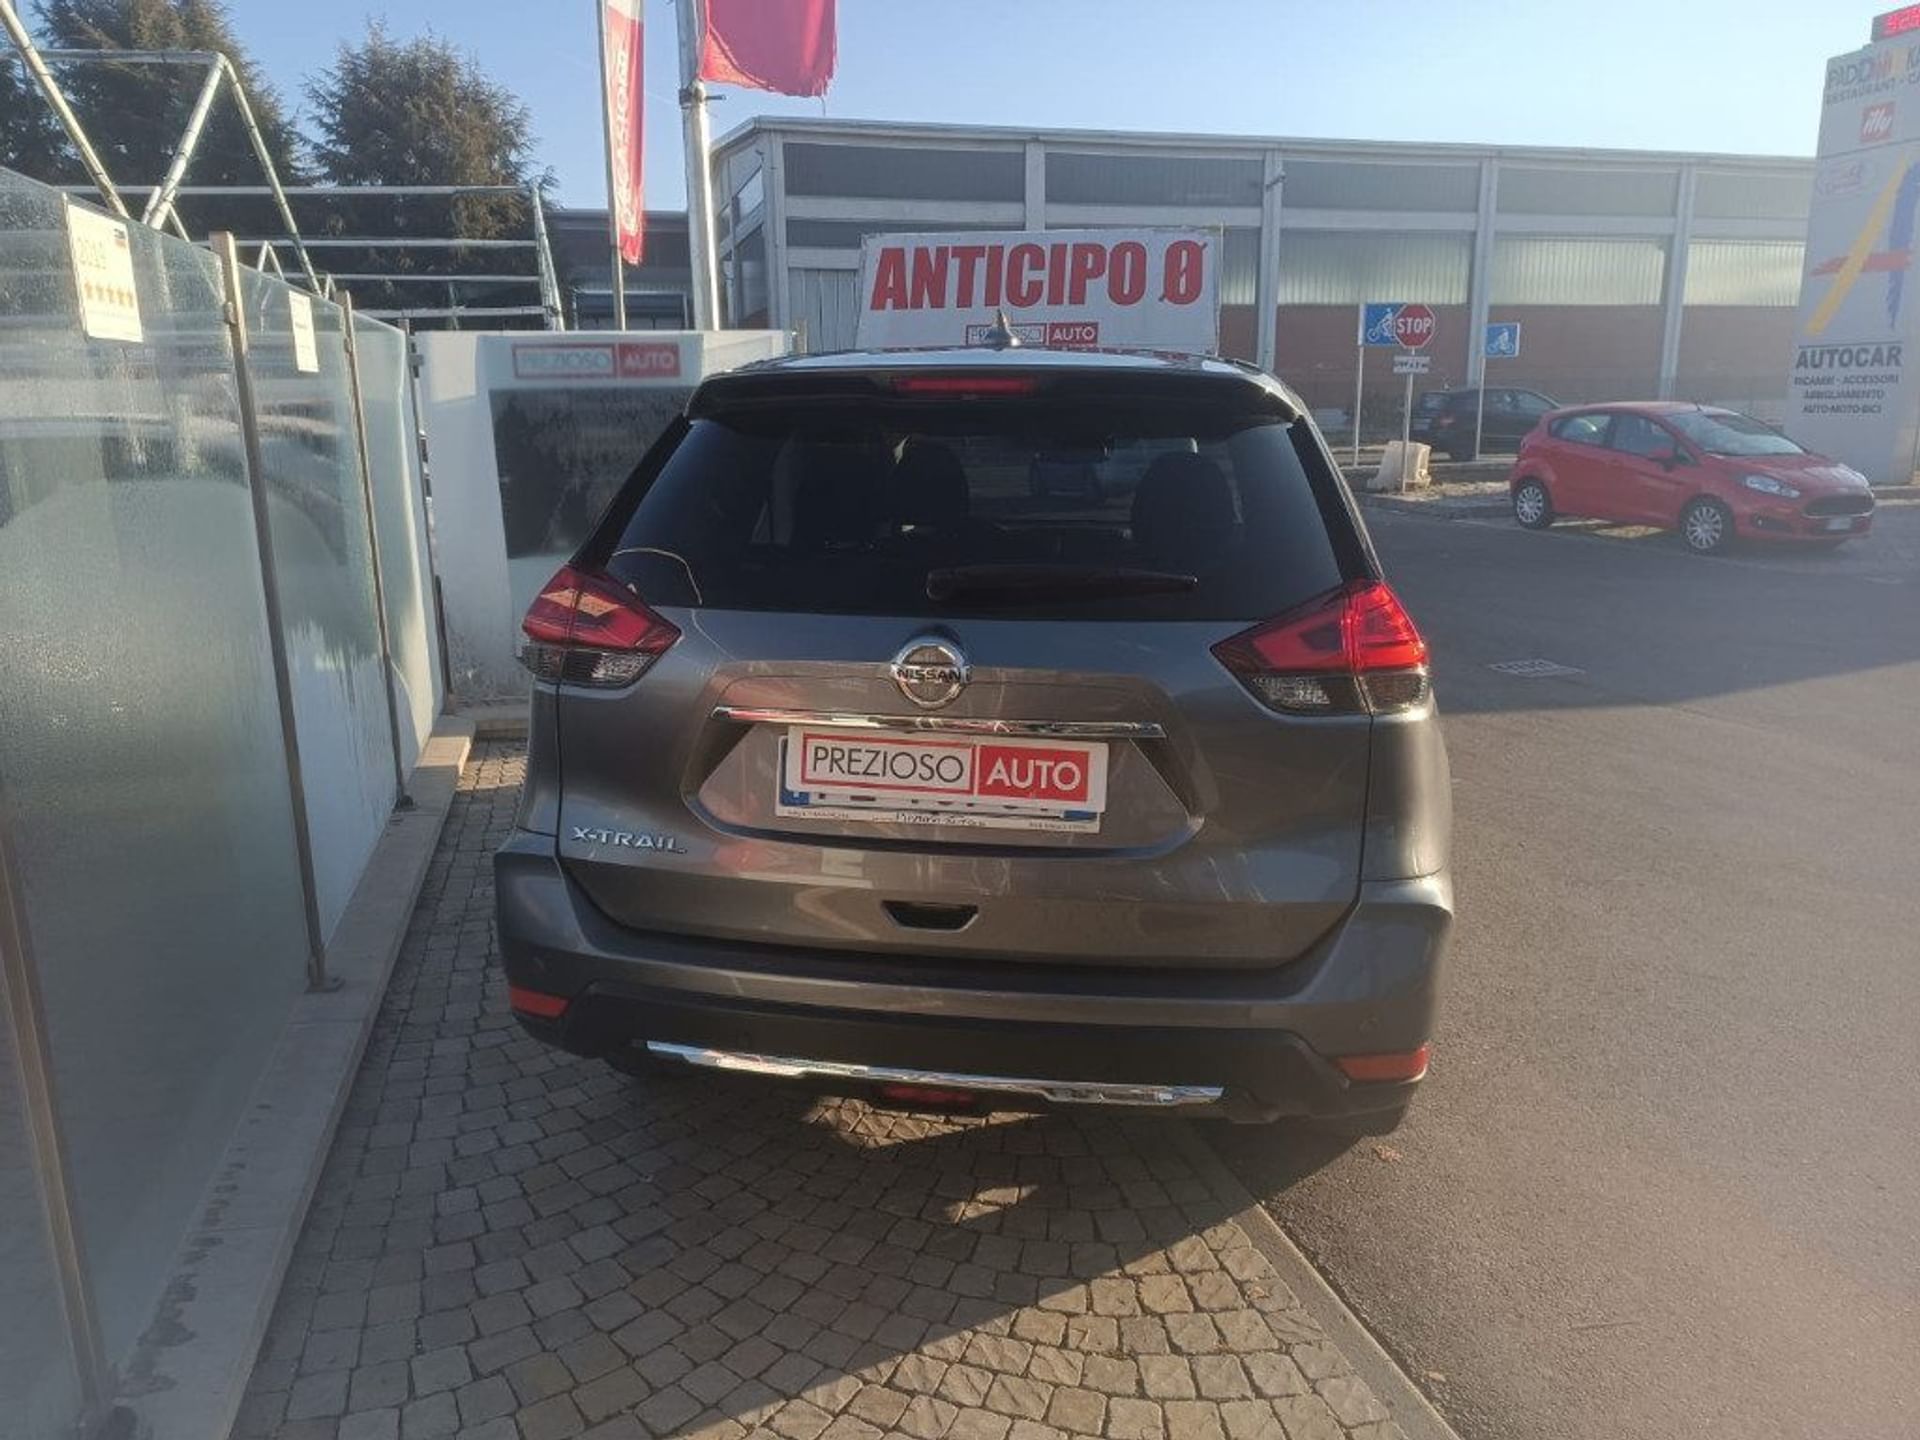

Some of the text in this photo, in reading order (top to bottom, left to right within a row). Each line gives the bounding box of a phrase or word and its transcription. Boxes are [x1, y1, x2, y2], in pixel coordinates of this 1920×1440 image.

[1862, 106, 1892, 136] illy
[870, 241, 1147, 311] ANTICIPO
[1051, 326, 1097, 341] AUTO
[1396, 316, 1433, 334] STOP
[624, 351, 675, 369] AUTO
[1795, 345, 1903, 369] AUTOCAR
[1842, 373, 1899, 384] ACCESSORI
[897, 668, 962, 683] NISSAN
[812, 745, 1082, 792] PREZIOSO AUTO
[571, 825, 688, 855] X-TRAIL
